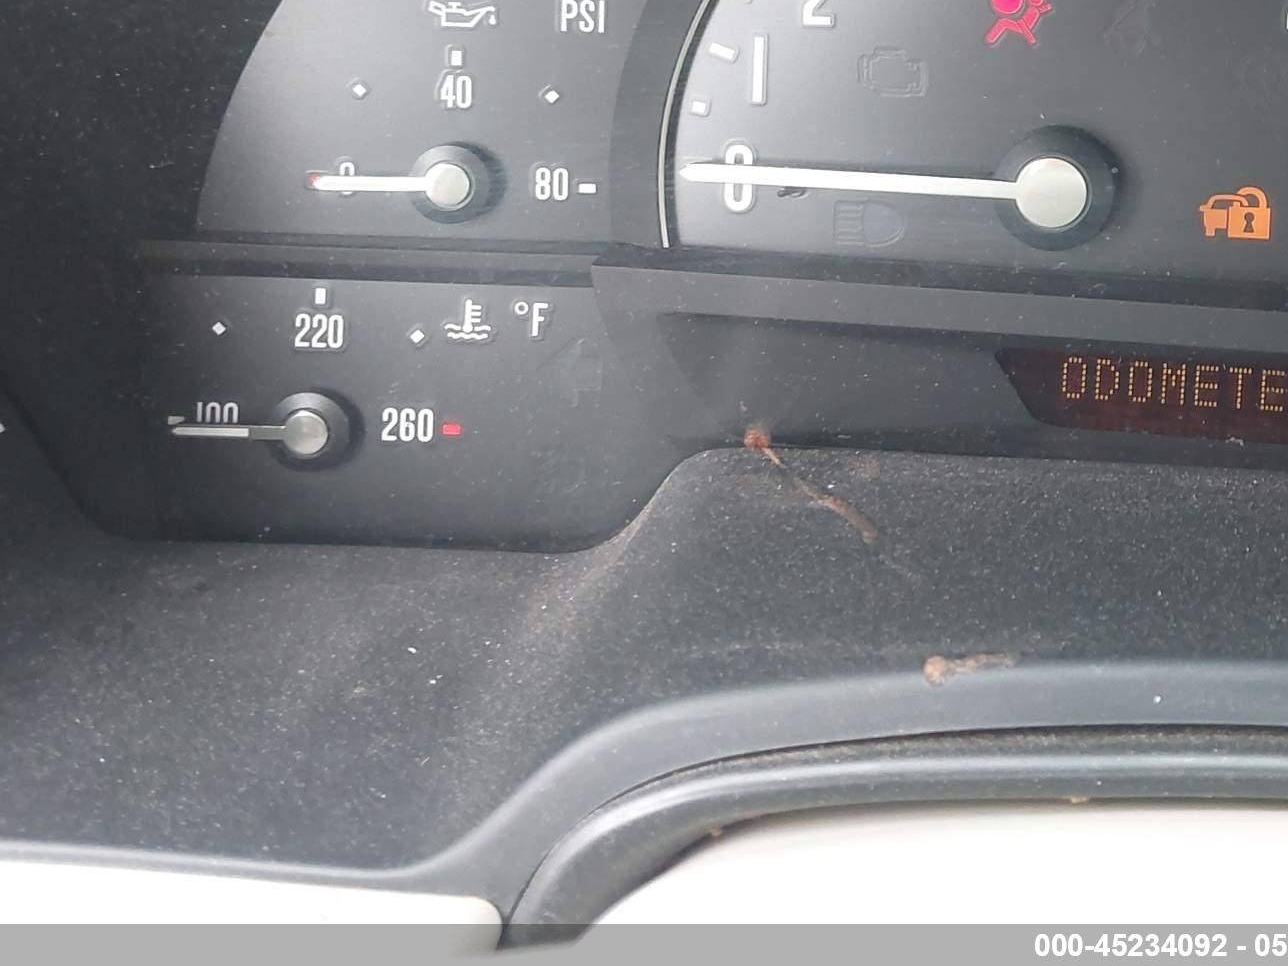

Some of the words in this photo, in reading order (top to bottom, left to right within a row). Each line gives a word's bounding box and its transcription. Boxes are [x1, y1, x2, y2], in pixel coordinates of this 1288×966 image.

[751, 36, 765, 103] 1
[440, 74, 472, 109] 40
[535, 167, 569, 201] 80
[723, 145, 754, 212] 0
[294, 313, 344, 349] 220
[381, 407, 434, 443] 260
